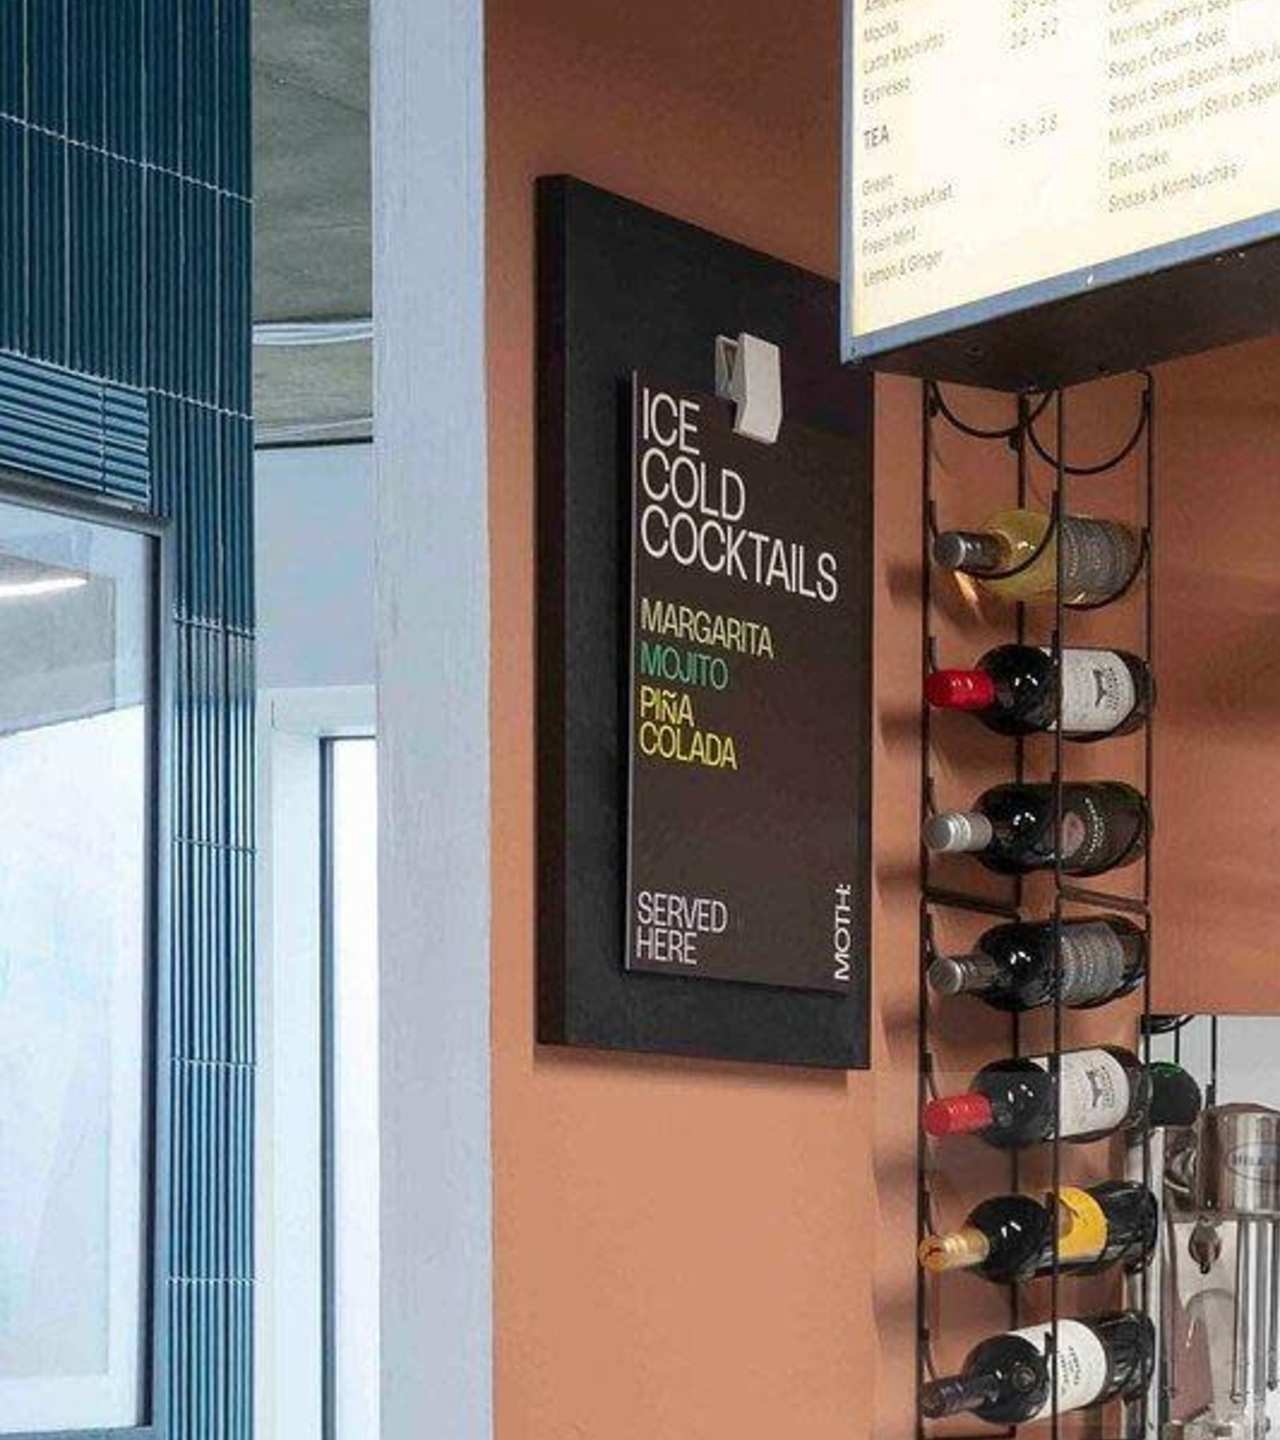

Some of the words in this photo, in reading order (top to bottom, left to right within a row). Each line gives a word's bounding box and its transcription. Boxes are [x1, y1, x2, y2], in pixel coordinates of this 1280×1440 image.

[863, 124, 889, 148] TEA
[641, 387, 700, 455] ICE
[641, 449, 746, 523] COLD
[640, 506, 839, 603] COCKTAILS
[641, 598, 774, 659] MARGARITA
[640, 641, 729, 691] MOJITO
[640, 686, 695, 728] PIÑA
[640, 720, 738, 770] COLADA
[637, 891, 728, 935] SERVED
[833, 883, 852, 980] MOTH:
[636, 926, 698, 966] HERE
